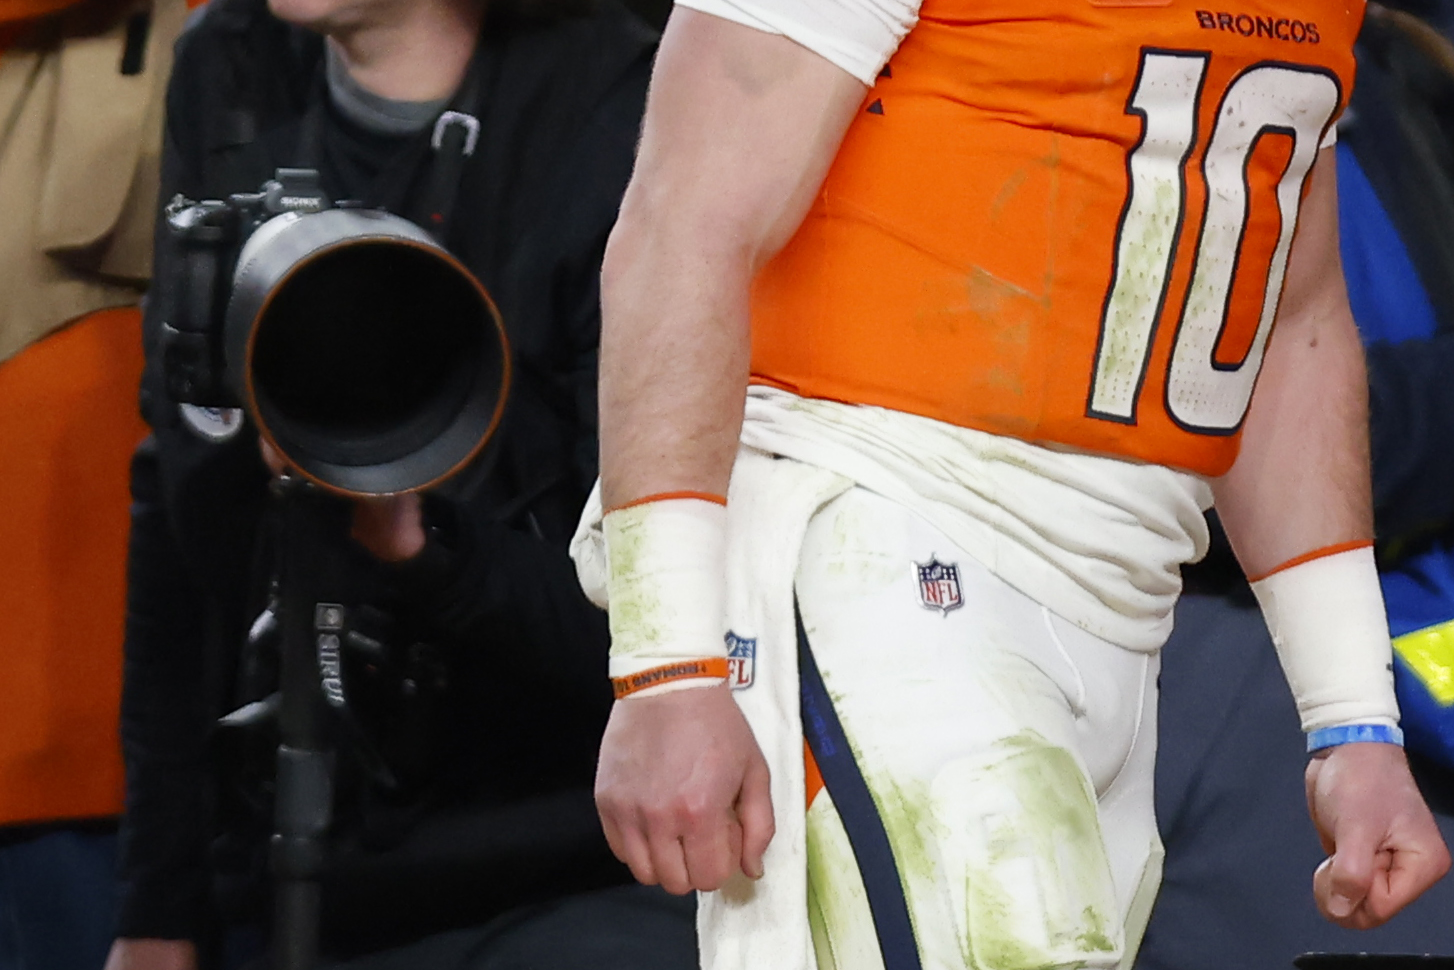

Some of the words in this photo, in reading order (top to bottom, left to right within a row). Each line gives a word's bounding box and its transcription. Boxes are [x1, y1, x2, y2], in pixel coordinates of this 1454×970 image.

[1195, 10, 1320, 44] BRONCOS
[1085, 45, 1342, 436] 10
[925, 581, 959, 604] NFL
[728, 658, 749, 685] FL
